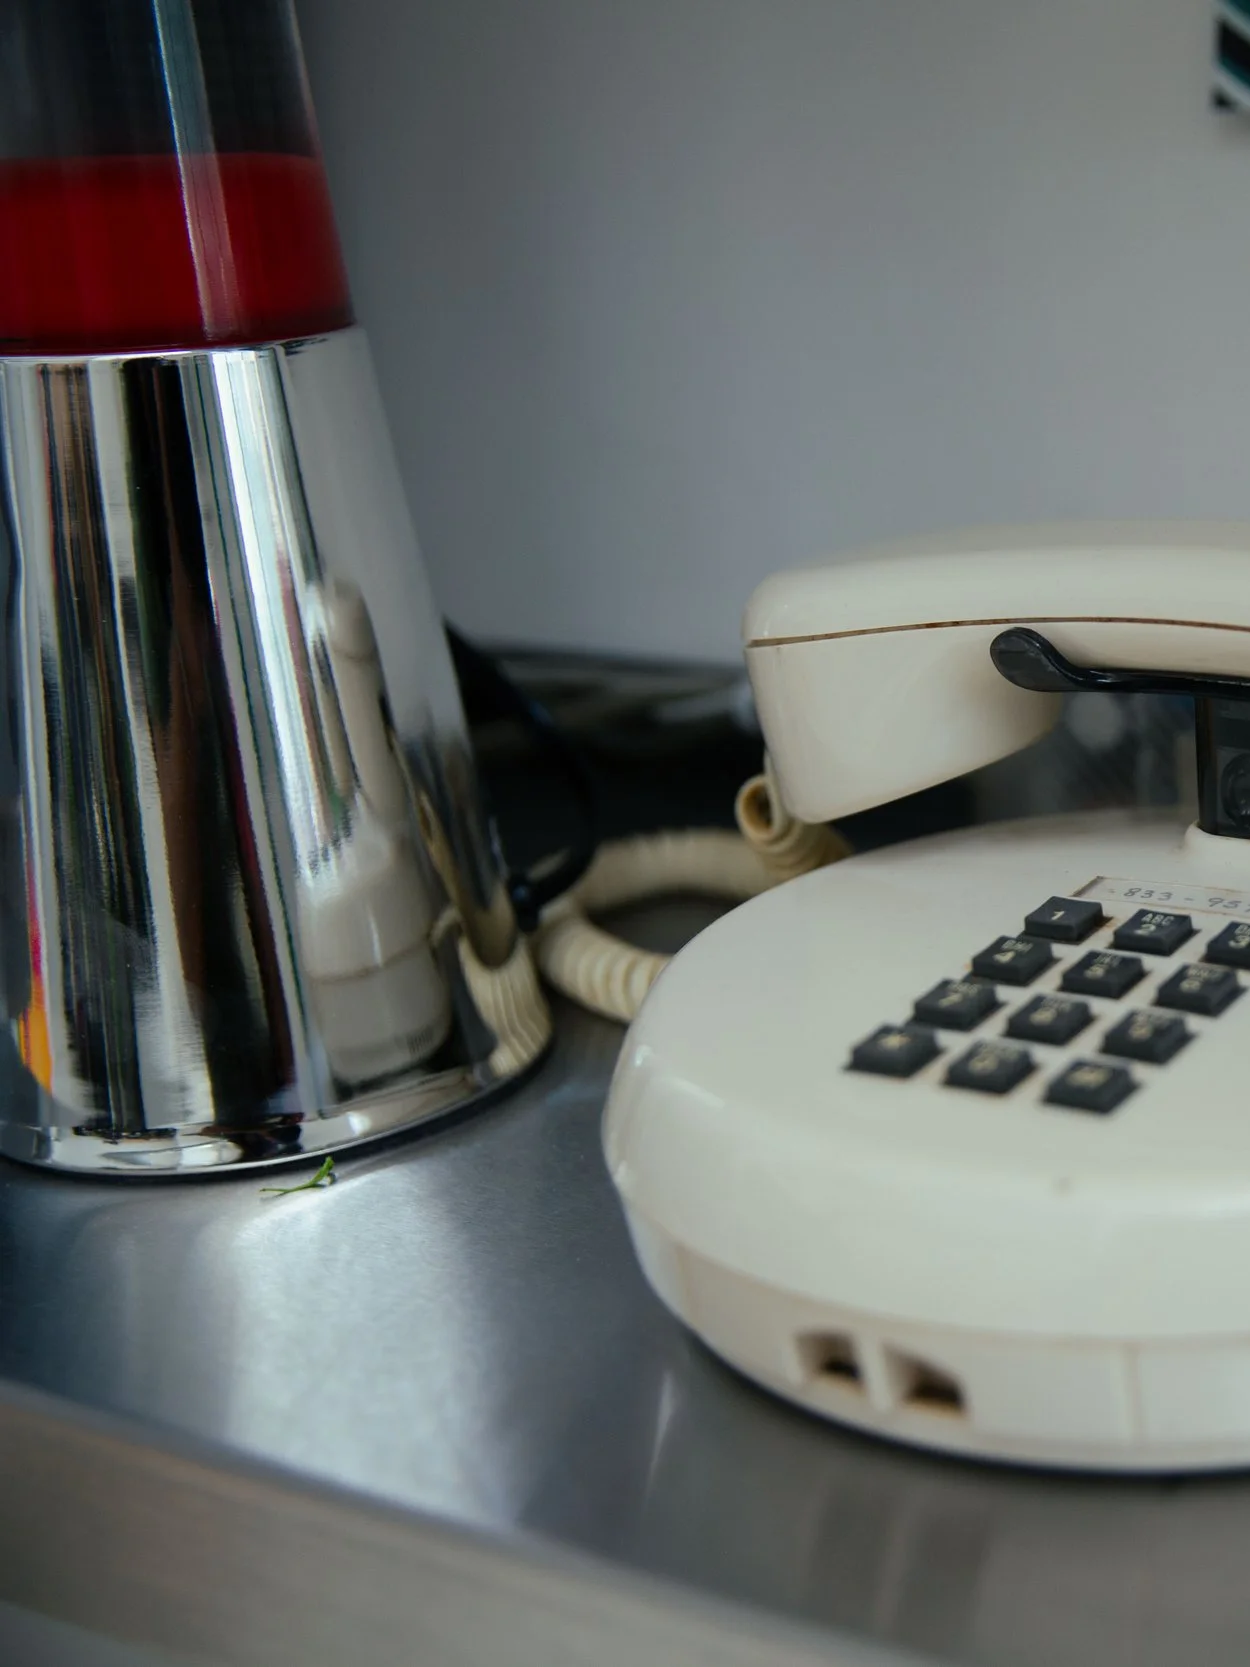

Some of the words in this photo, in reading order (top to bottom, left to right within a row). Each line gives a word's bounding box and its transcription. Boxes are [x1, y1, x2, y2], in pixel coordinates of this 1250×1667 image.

[1049, 910, 1065, 921] 1
[1141, 912, 1174, 925] ABC
[1134, 924, 1156, 935] 2
[992, 951, 1016, 963] 4
